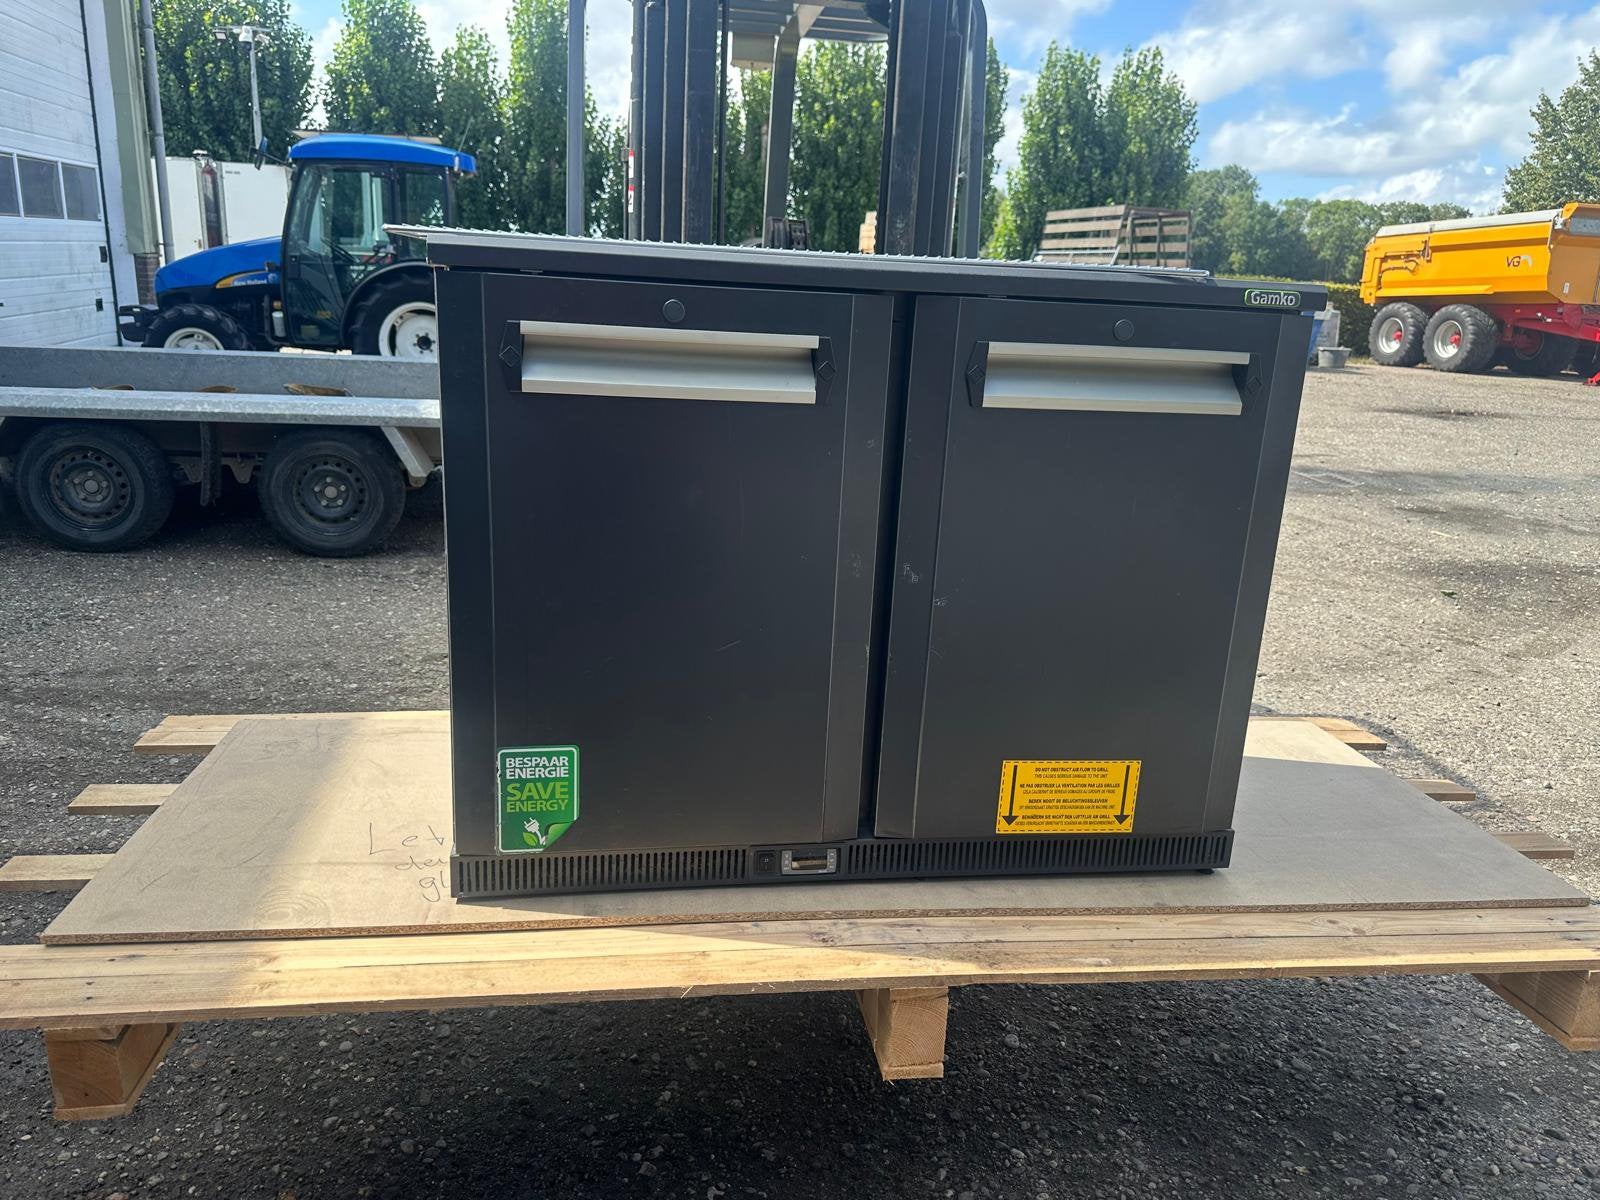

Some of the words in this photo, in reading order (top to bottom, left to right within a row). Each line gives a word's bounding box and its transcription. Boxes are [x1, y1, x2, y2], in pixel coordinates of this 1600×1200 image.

[1250, 291, 1296, 306] Gamko
[505, 756, 569, 768] BESPAAR
[505, 767, 569, 779] ENERGIE
[506, 781, 569, 801] SAVE
[506, 800, 569, 813] ENERGY
